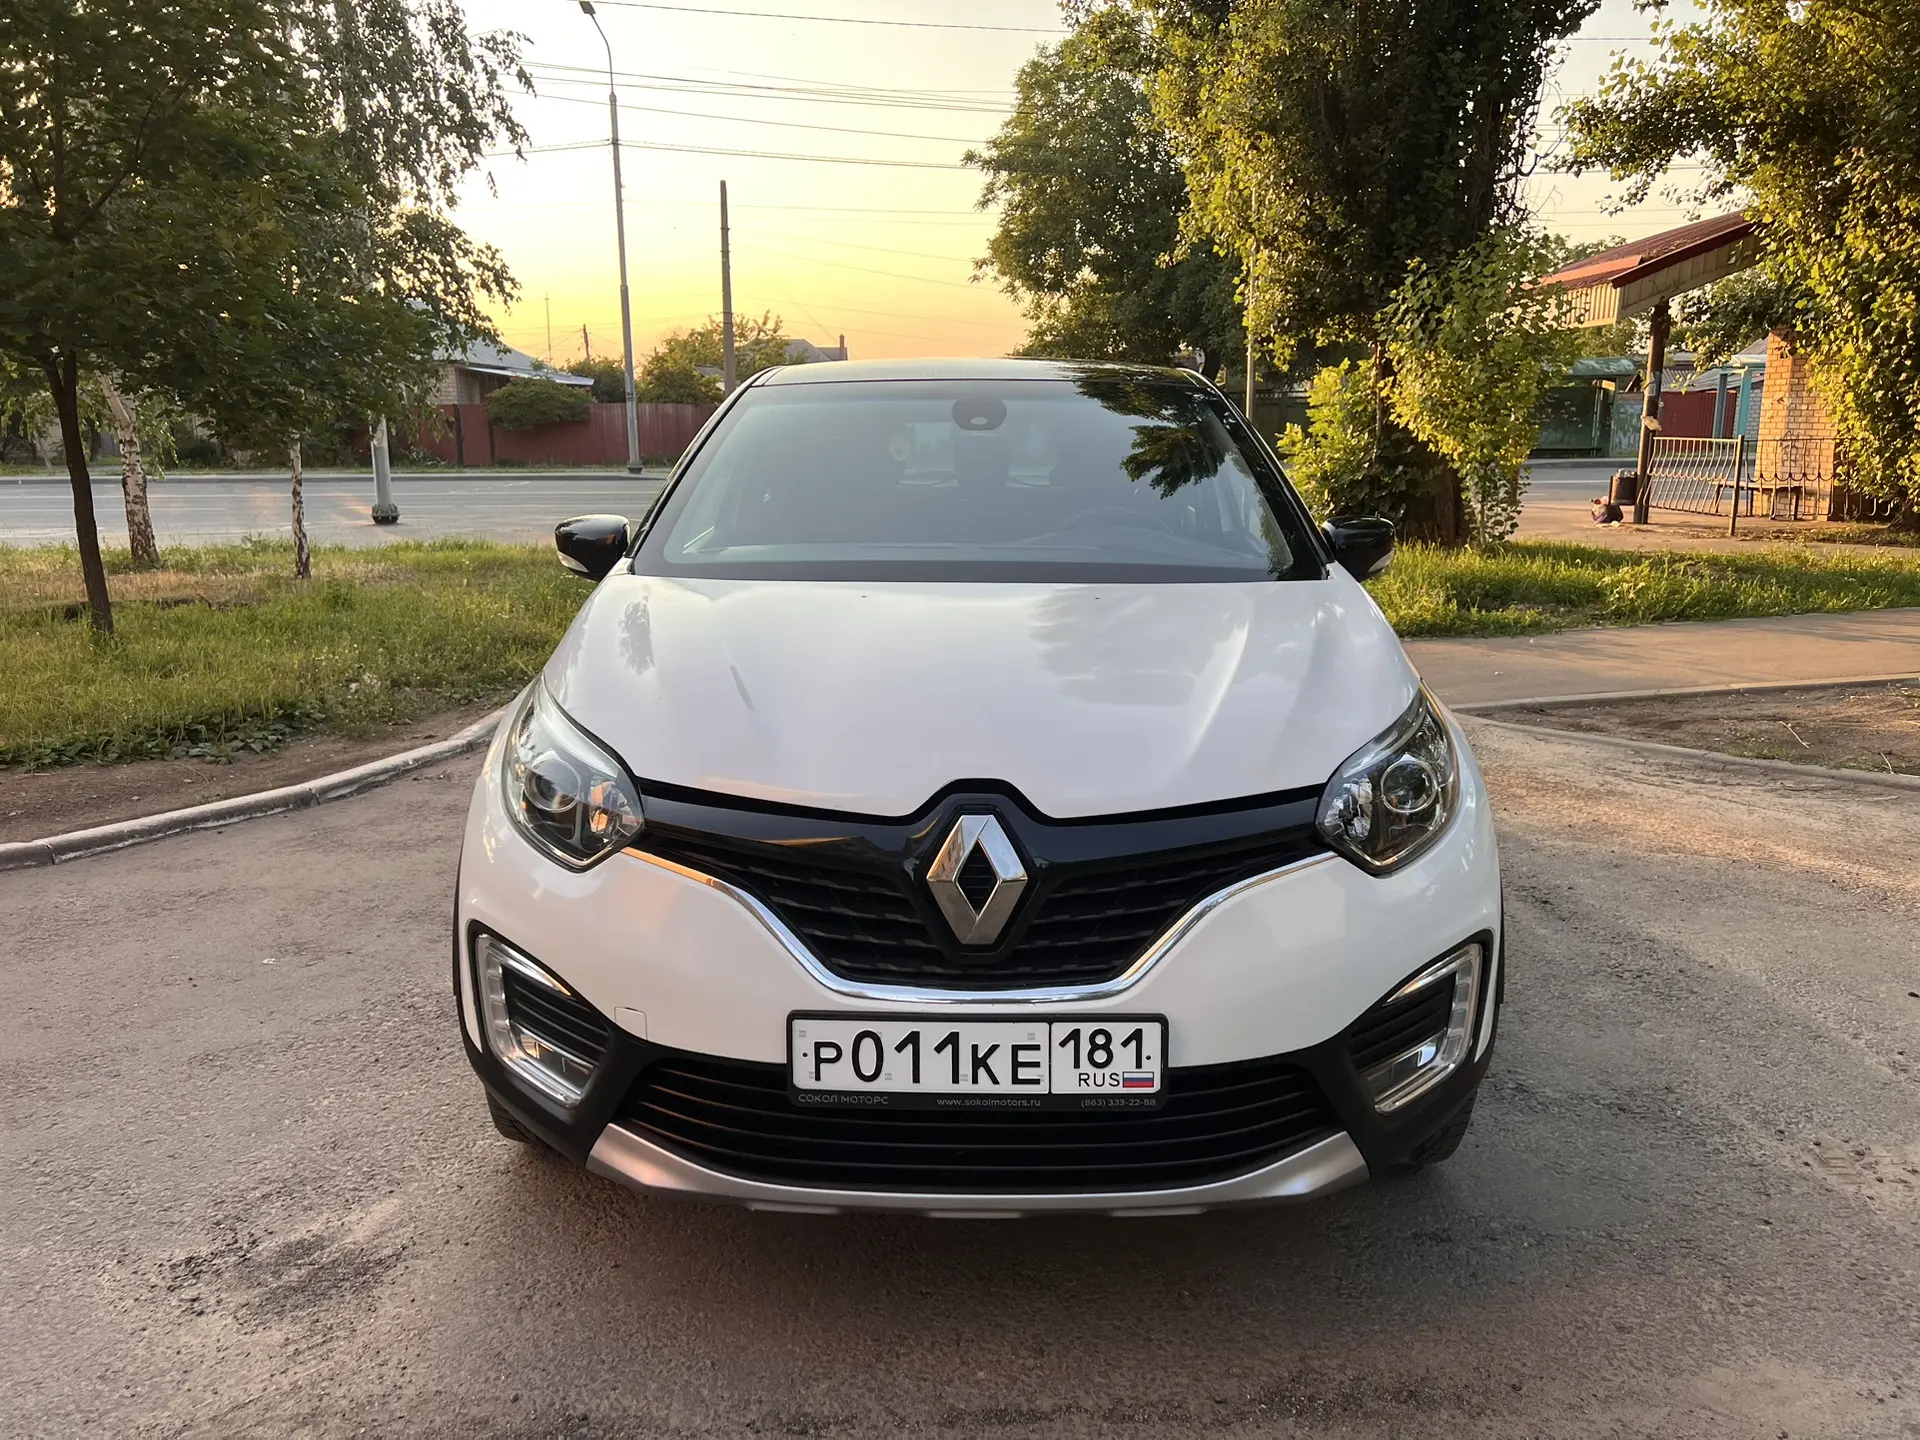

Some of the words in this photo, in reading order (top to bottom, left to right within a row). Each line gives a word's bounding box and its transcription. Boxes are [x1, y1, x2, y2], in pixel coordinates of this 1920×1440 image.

[1059, 1028, 1144, 1070] 181
[1078, 1073, 1120, 1088] RUS
[798, 1094, 838, 1103] СОКОЛ
[840, 1095, 889, 1105] МОТОРС
[936, 1098, 1041, 1107] www.sokolmotors.ru
